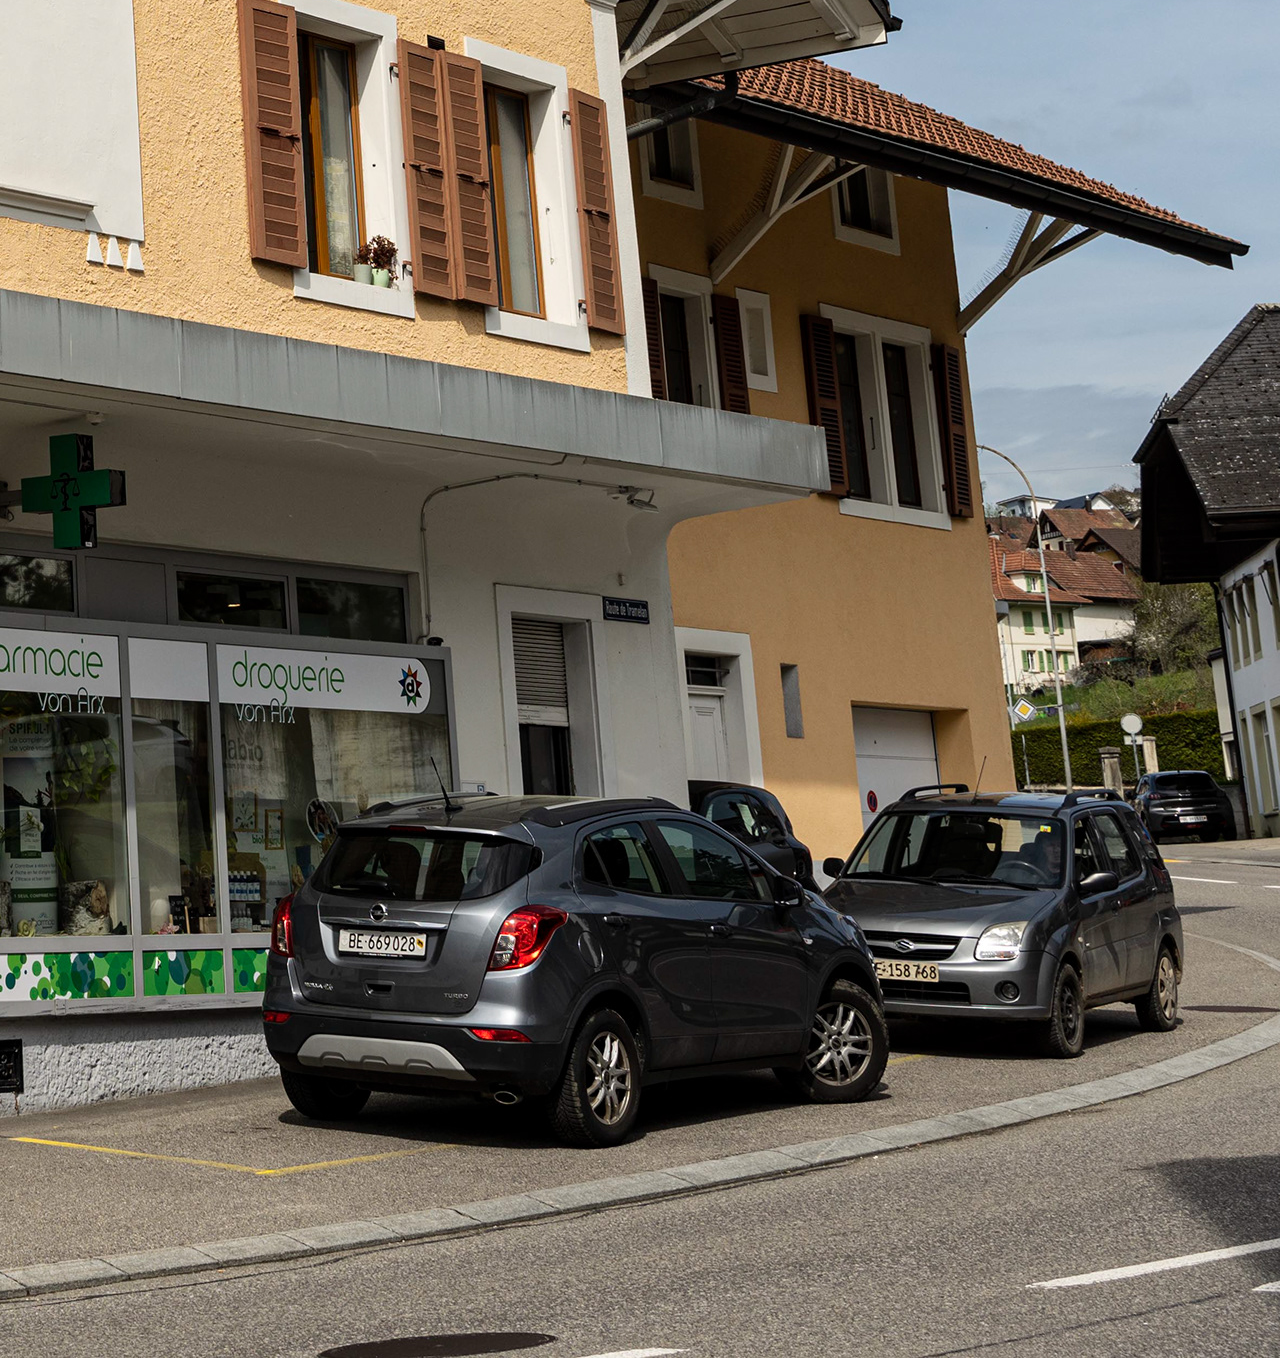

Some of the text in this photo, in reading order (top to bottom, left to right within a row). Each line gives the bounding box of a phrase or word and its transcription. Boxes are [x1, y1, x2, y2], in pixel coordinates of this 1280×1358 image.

[605, 600, 648, 618] Route de Tramelan
[232, 650, 345, 705] droguerie
[37, 687, 105, 715] von Arx
[235, 698, 296, 724] von Arx
